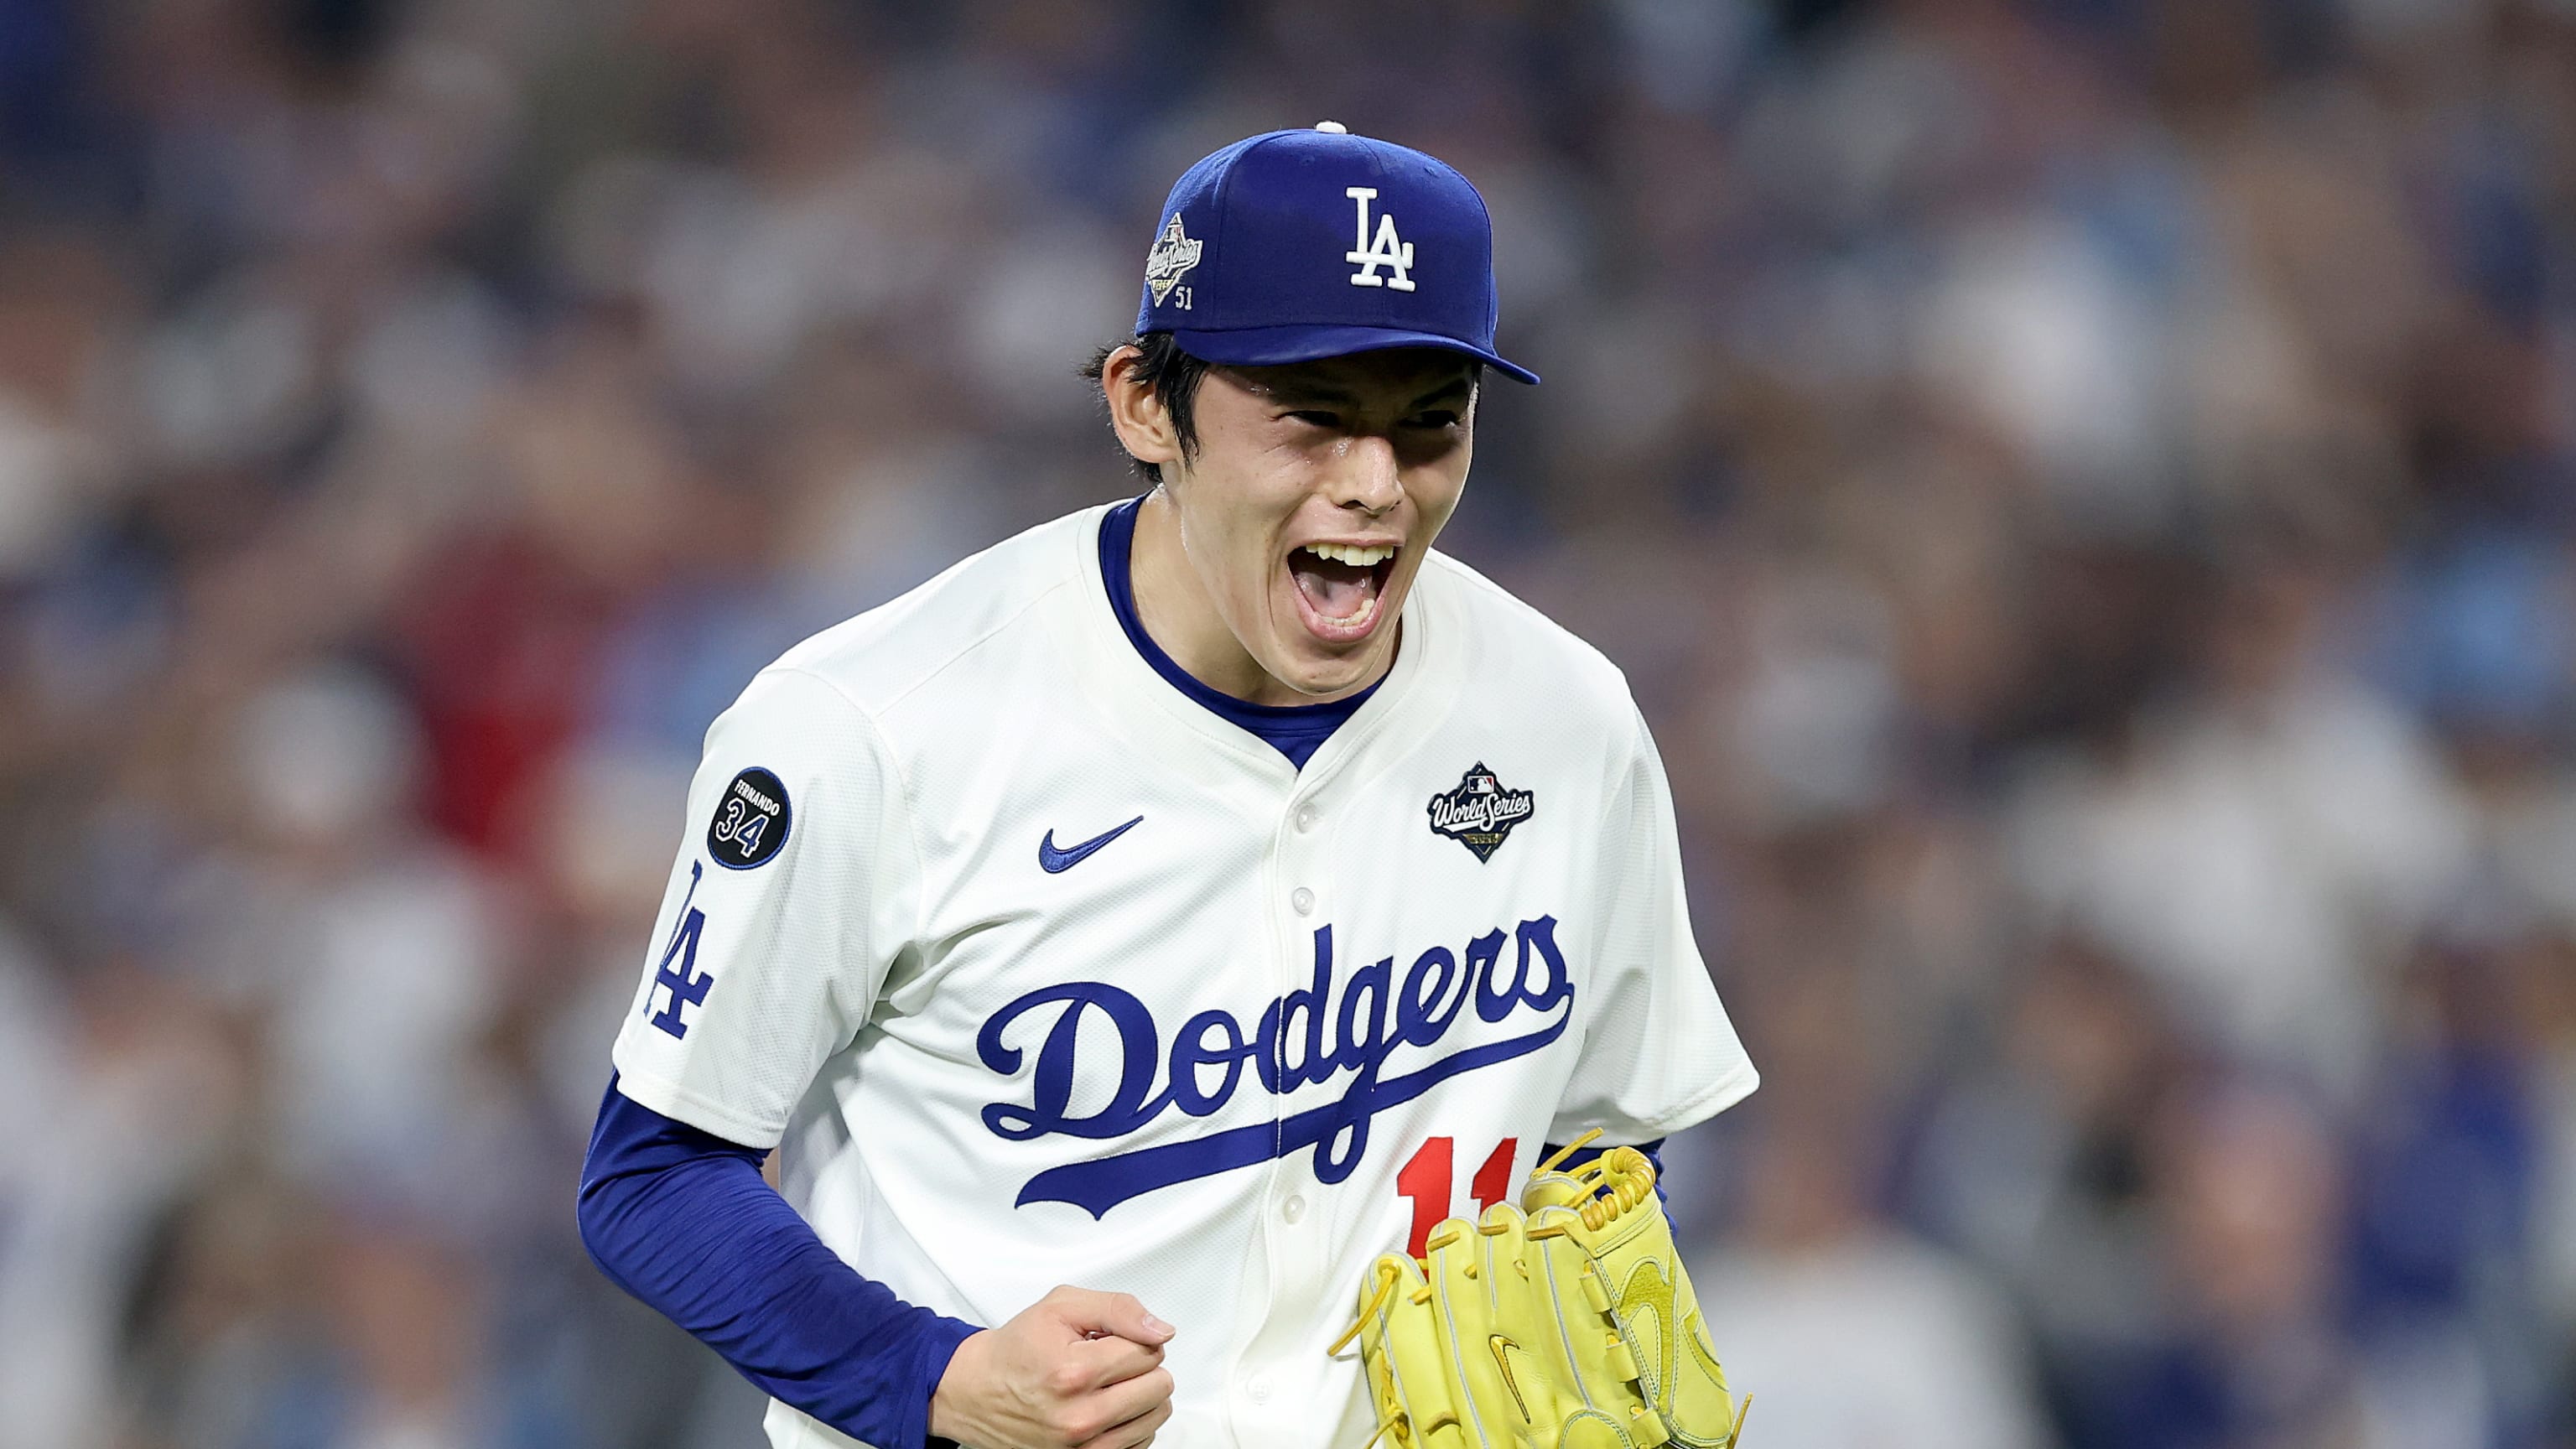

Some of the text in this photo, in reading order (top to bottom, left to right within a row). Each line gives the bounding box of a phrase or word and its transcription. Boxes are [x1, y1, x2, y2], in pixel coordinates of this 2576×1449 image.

[1346, 187, 1415, 292] LA
[1175, 286, 1192, 310] 51
[715, 797, 770, 859] 34
[734, 778, 781, 817] FERNANDO
[1432, 792, 1531, 832] World Series
[643, 859, 714, 1041] LA
[977, 915, 1574, 1185] Dodgers
[1397, 1136, 1518, 1280] 11
